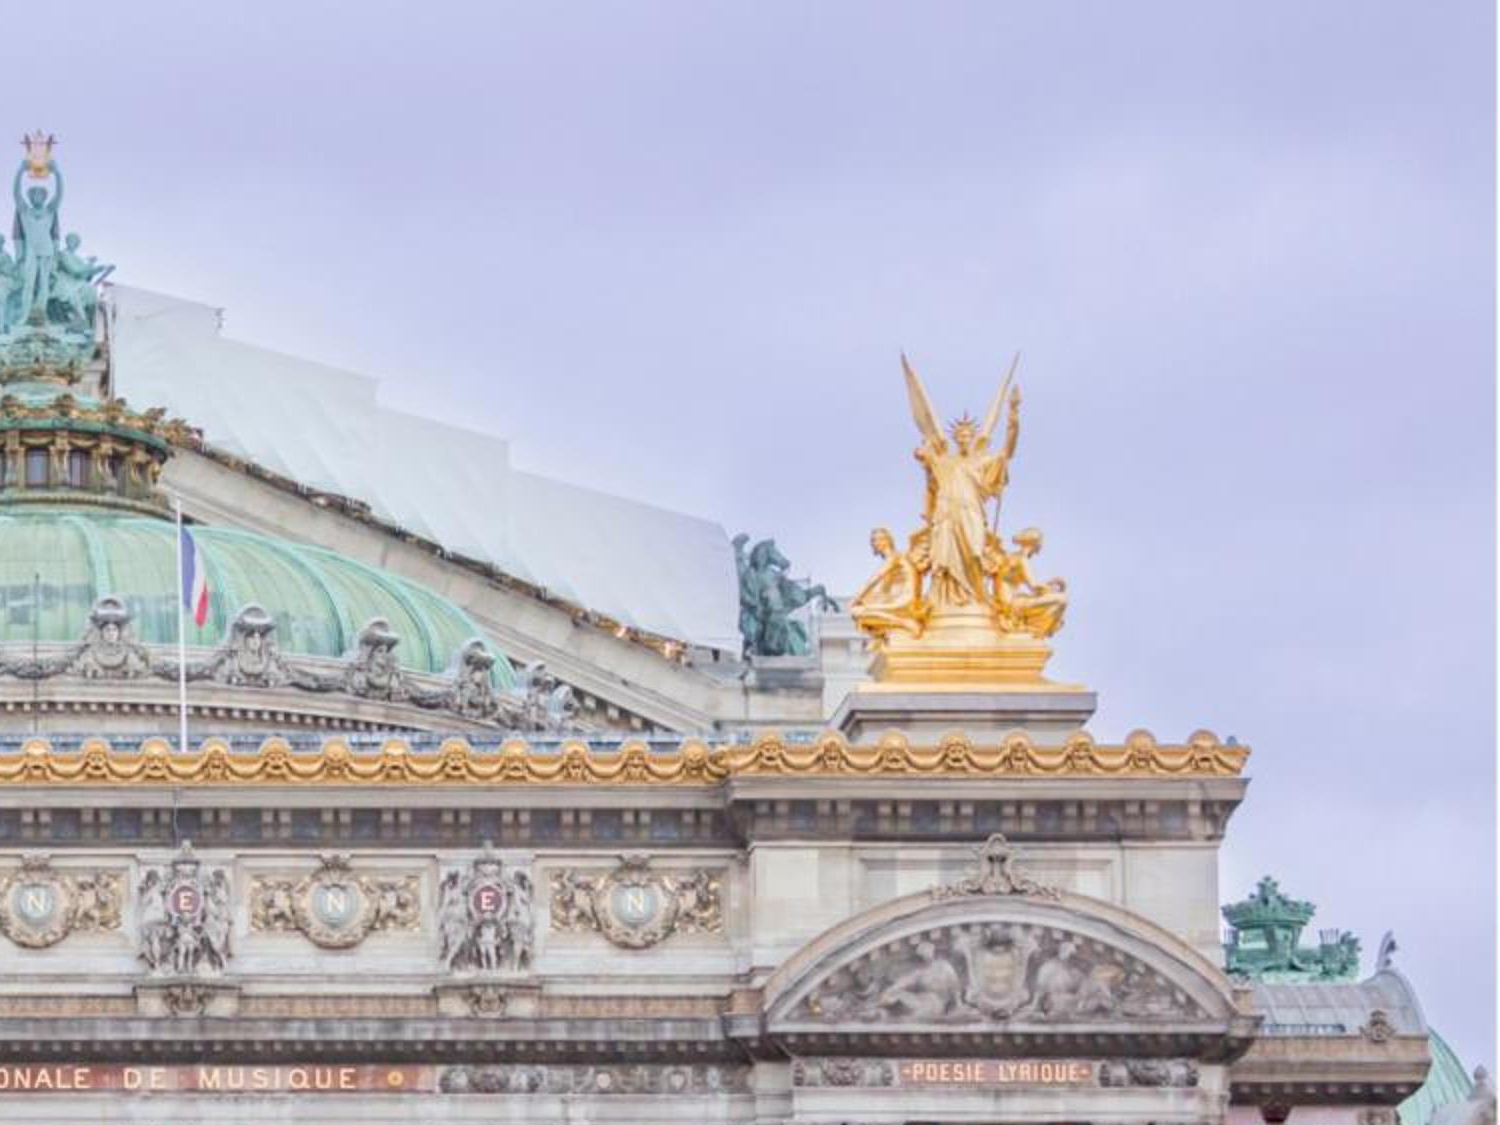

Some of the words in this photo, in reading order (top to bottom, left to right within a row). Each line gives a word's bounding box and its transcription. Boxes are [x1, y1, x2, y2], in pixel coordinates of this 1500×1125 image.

[26, 892, 46, 913] N
[178, 891, 193, 911] E
[326, 893, 346, 914] N
[479, 891, 494, 911] E
[626, 892, 645, 914] N
[123, 1067, 166, 1090] DE
[199, 1067, 357, 1091] MUSIQUE
[912, 1062, 985, 1082] POESIE
[999, 1062, 1078, 1083] LYRIQUE
